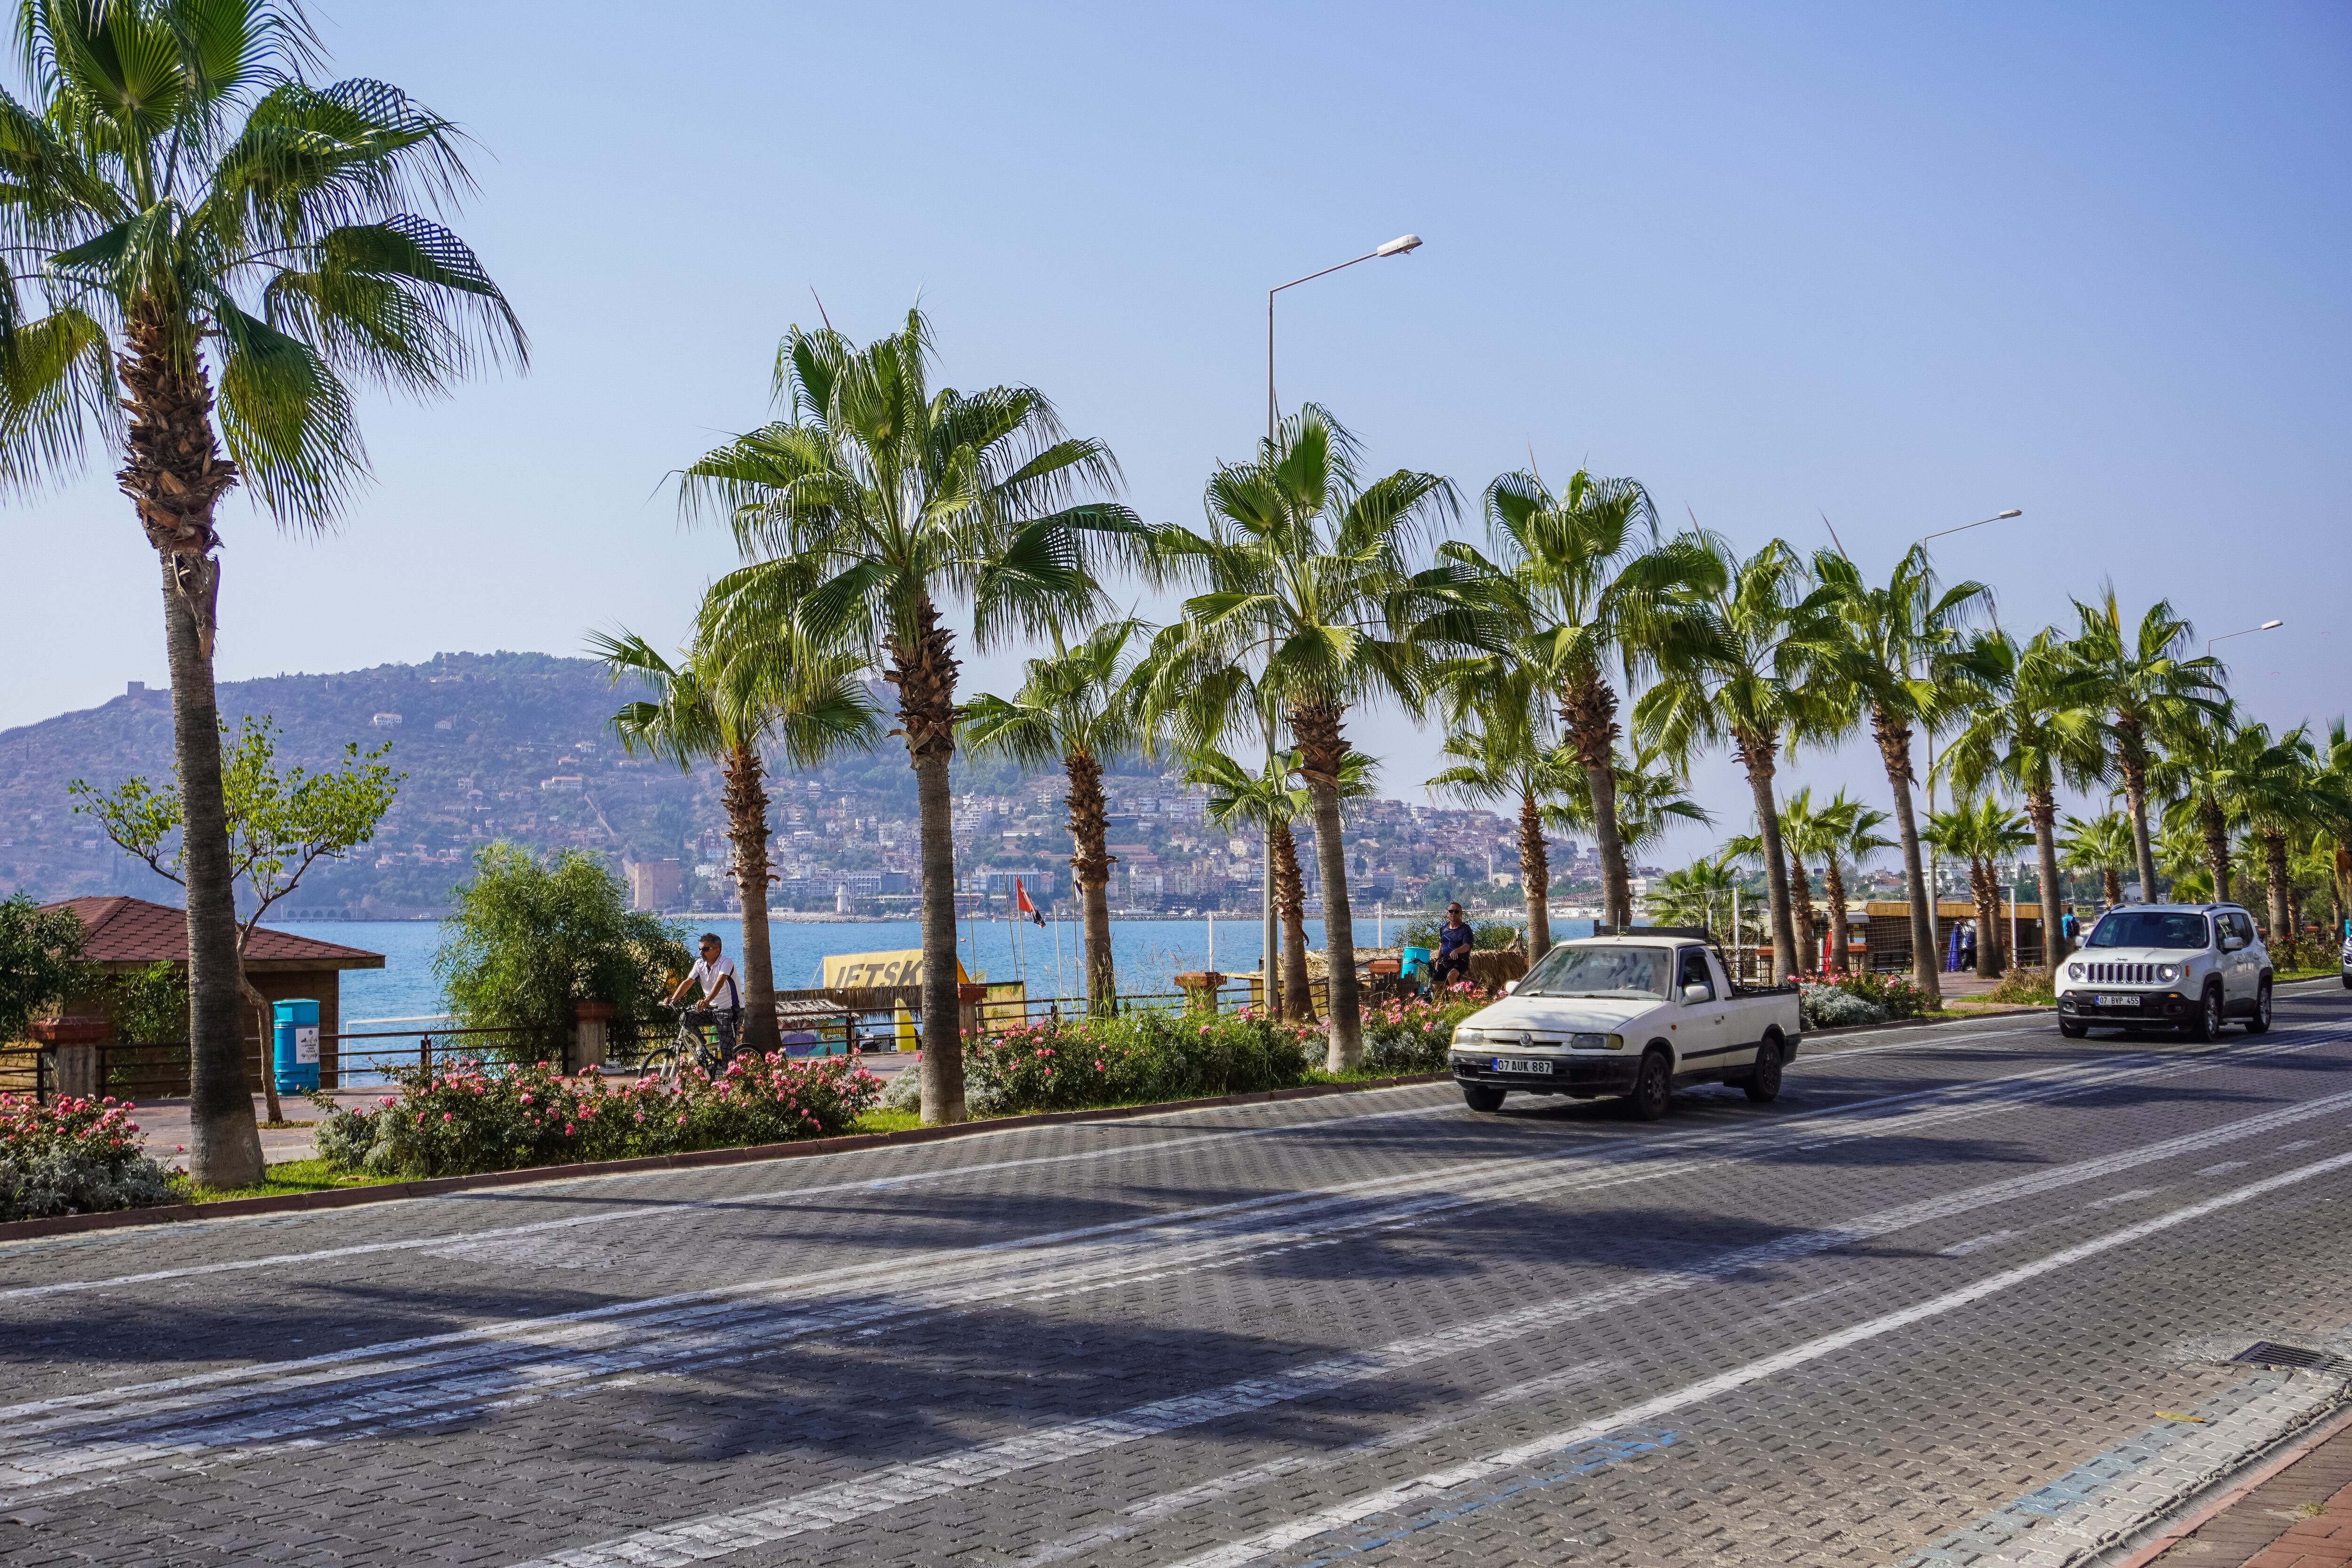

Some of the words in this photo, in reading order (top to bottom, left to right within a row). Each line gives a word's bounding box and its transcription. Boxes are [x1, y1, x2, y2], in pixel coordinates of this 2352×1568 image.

[834, 960, 923, 988] JETSK
[1498, 1060, 1509, 1070] 07
[1511, 1061, 1529, 1071] AUK
[1532, 1062, 1550, 1073] 887
